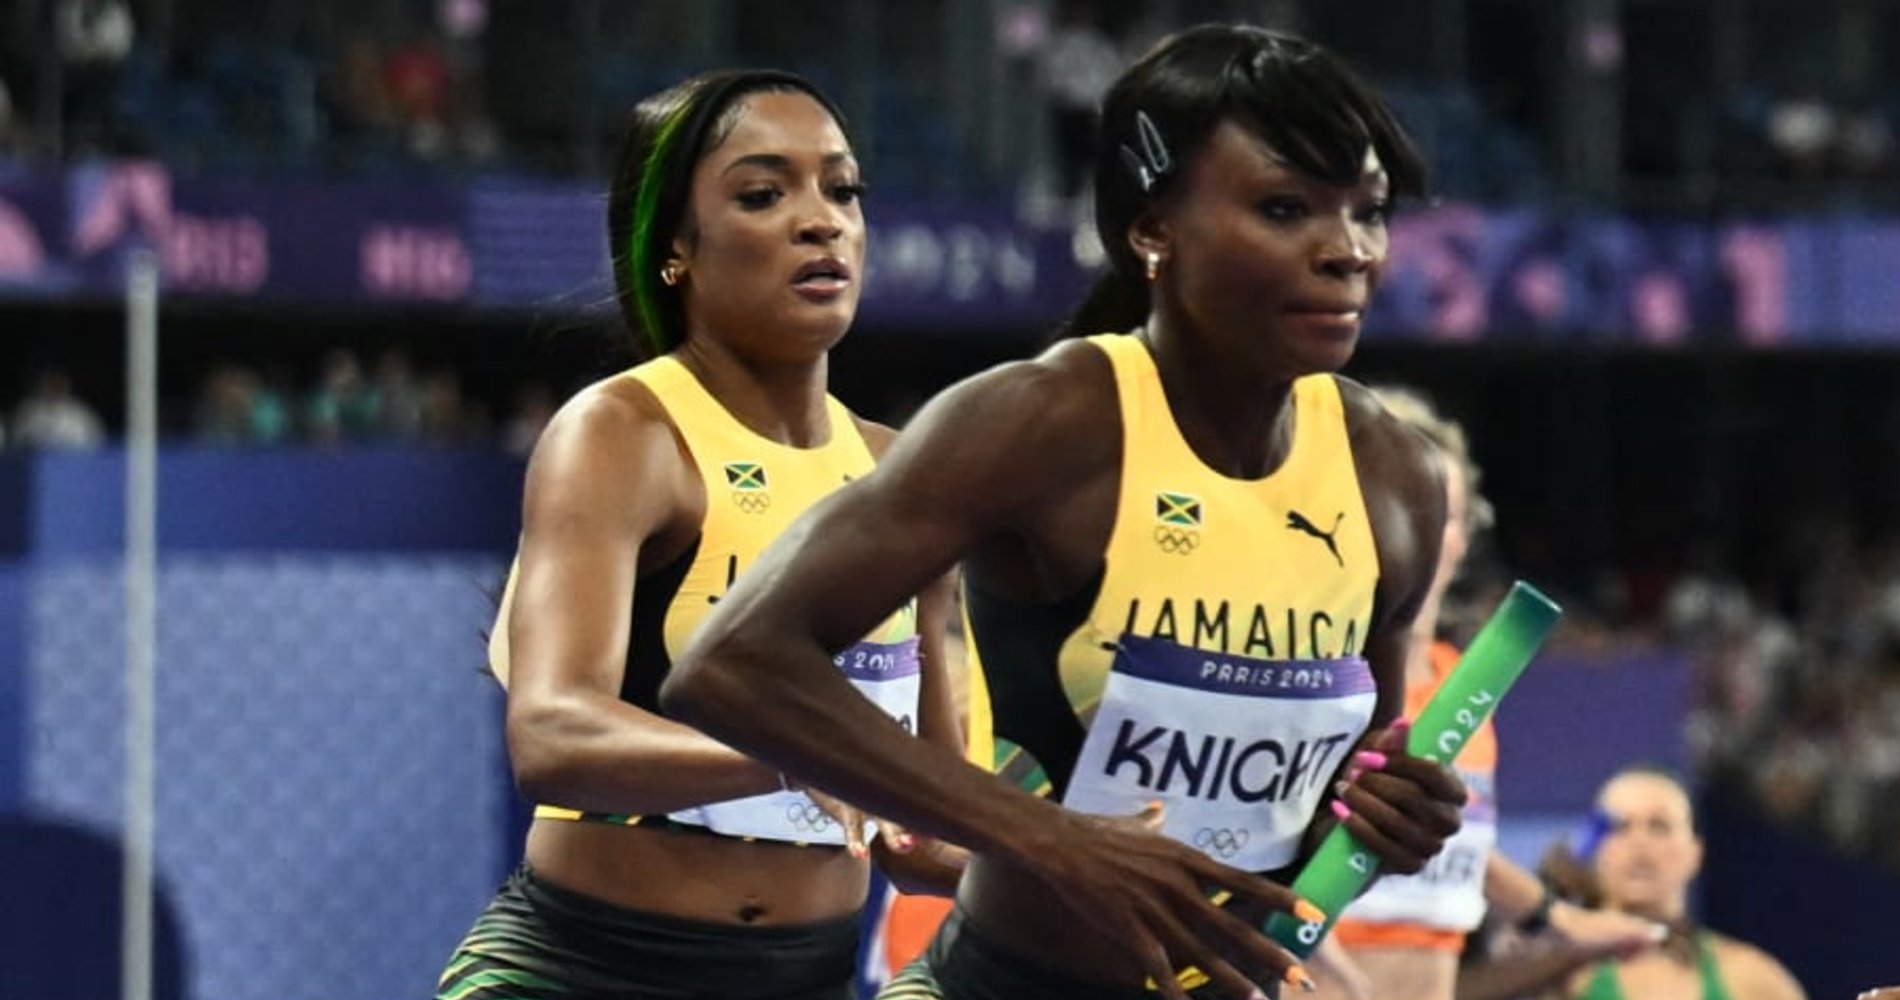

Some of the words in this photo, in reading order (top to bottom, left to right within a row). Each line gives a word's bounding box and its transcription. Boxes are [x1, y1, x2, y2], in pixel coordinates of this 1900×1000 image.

[1101, 598, 1357, 660] JAMAICA
[1201, 660, 1275, 686] PARIS
[1278, 667, 1334, 689] 2024
[1424, 689, 1494, 764] 024
[1104, 718, 1350, 804] KNIGHT
